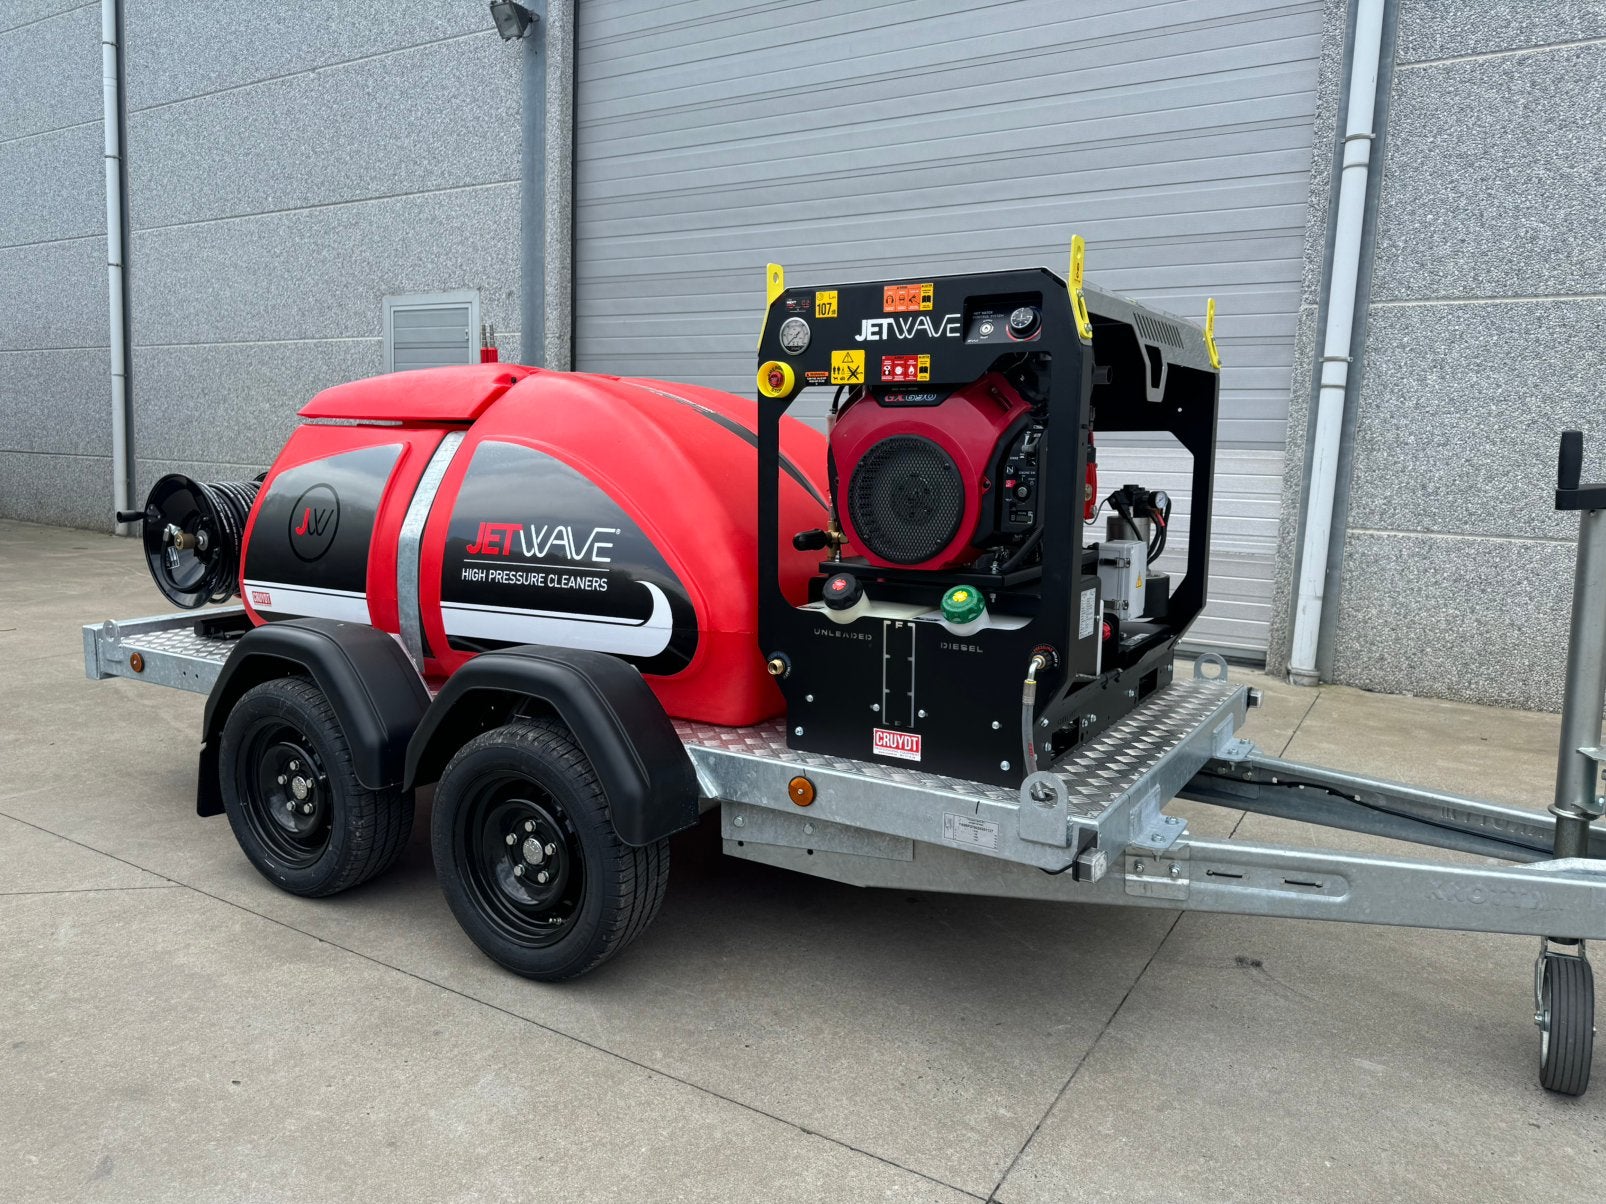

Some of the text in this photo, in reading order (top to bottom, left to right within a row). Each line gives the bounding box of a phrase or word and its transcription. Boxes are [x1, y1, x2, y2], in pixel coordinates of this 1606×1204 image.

[817, 303, 832, 315] 107
[855, 314, 961, 341] JETWAVE
[461, 568, 608, 592] HIGH PRESSURE CLEANERS
[814, 628, 873, 641] UNLEADED
[940, 642, 984, 653] DIESEL
[876, 731, 919, 752] CRUYDT
